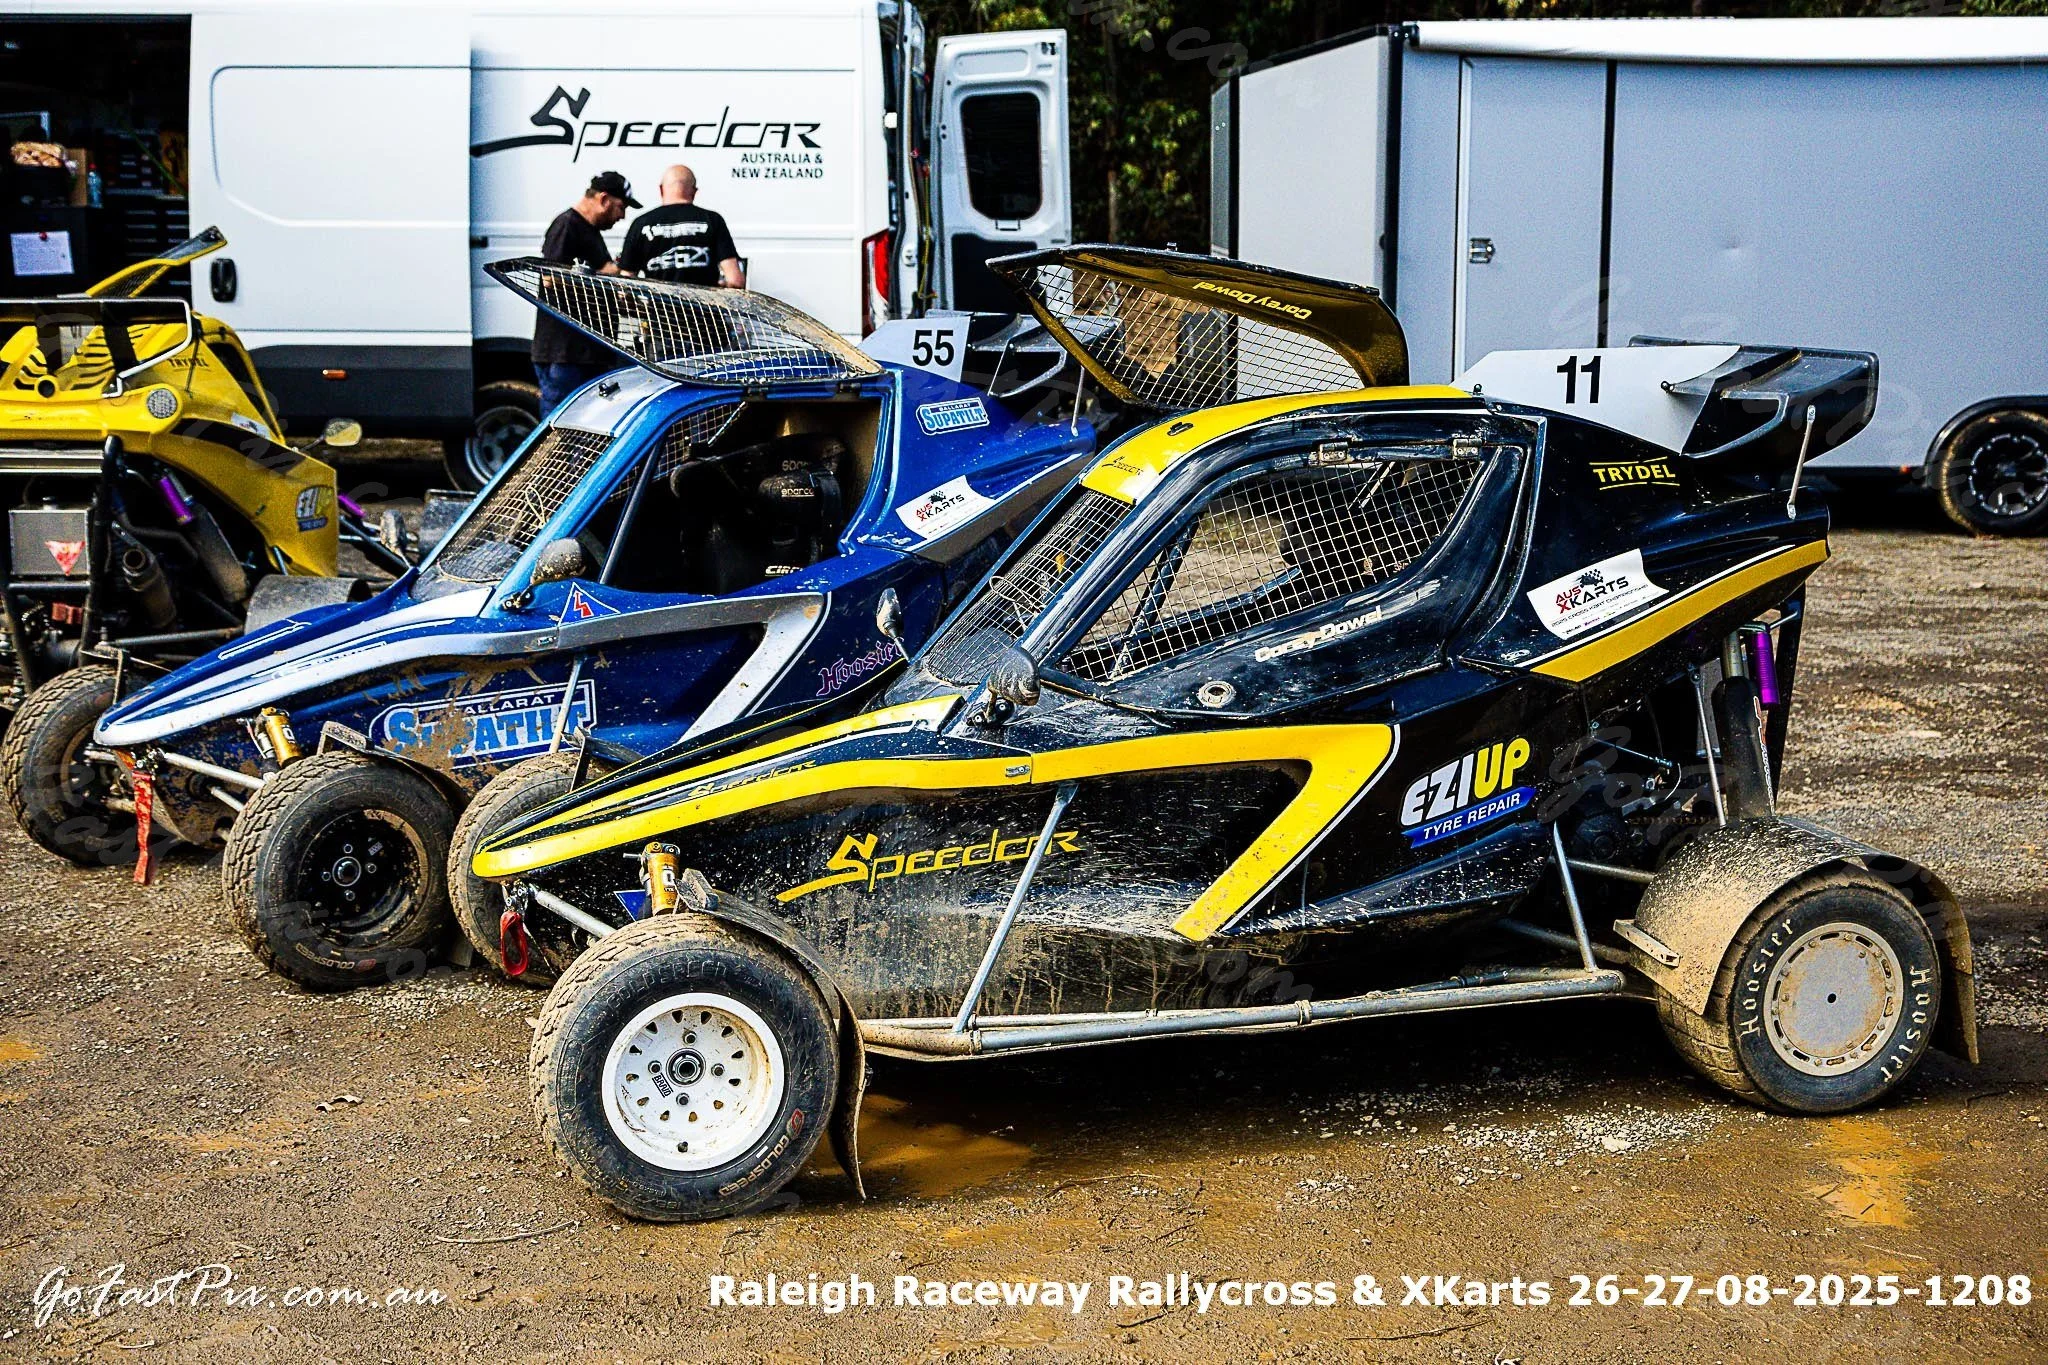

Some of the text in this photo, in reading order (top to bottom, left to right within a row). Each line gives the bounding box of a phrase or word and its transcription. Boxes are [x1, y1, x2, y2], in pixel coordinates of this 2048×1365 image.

[741, 153, 823, 164] AUSTRALIA &
[731, 168, 823, 179] NEW ZEALAND
[912, 329, 956, 367] 55
[1557, 355, 1602, 405] 11
[1593, 463, 1677, 484] TRYDEL
[781, 487, 815, 497] sparco
[916, 502, 933, 518] AUS
[918, 494, 965, 522] XKARTS
[1555, 585, 1582, 604] AUS
[1556, 576, 1629, 614] XKARTS
[816, 636, 905, 697] Hoosier
[449, 694, 555, 717] ALLARAT
[1423, 792, 1521, 840] TYRE REPAIR
[654, 1074, 673, 1098] BRAID
[718, 1134, 790, 1197] GOLDSPEED
